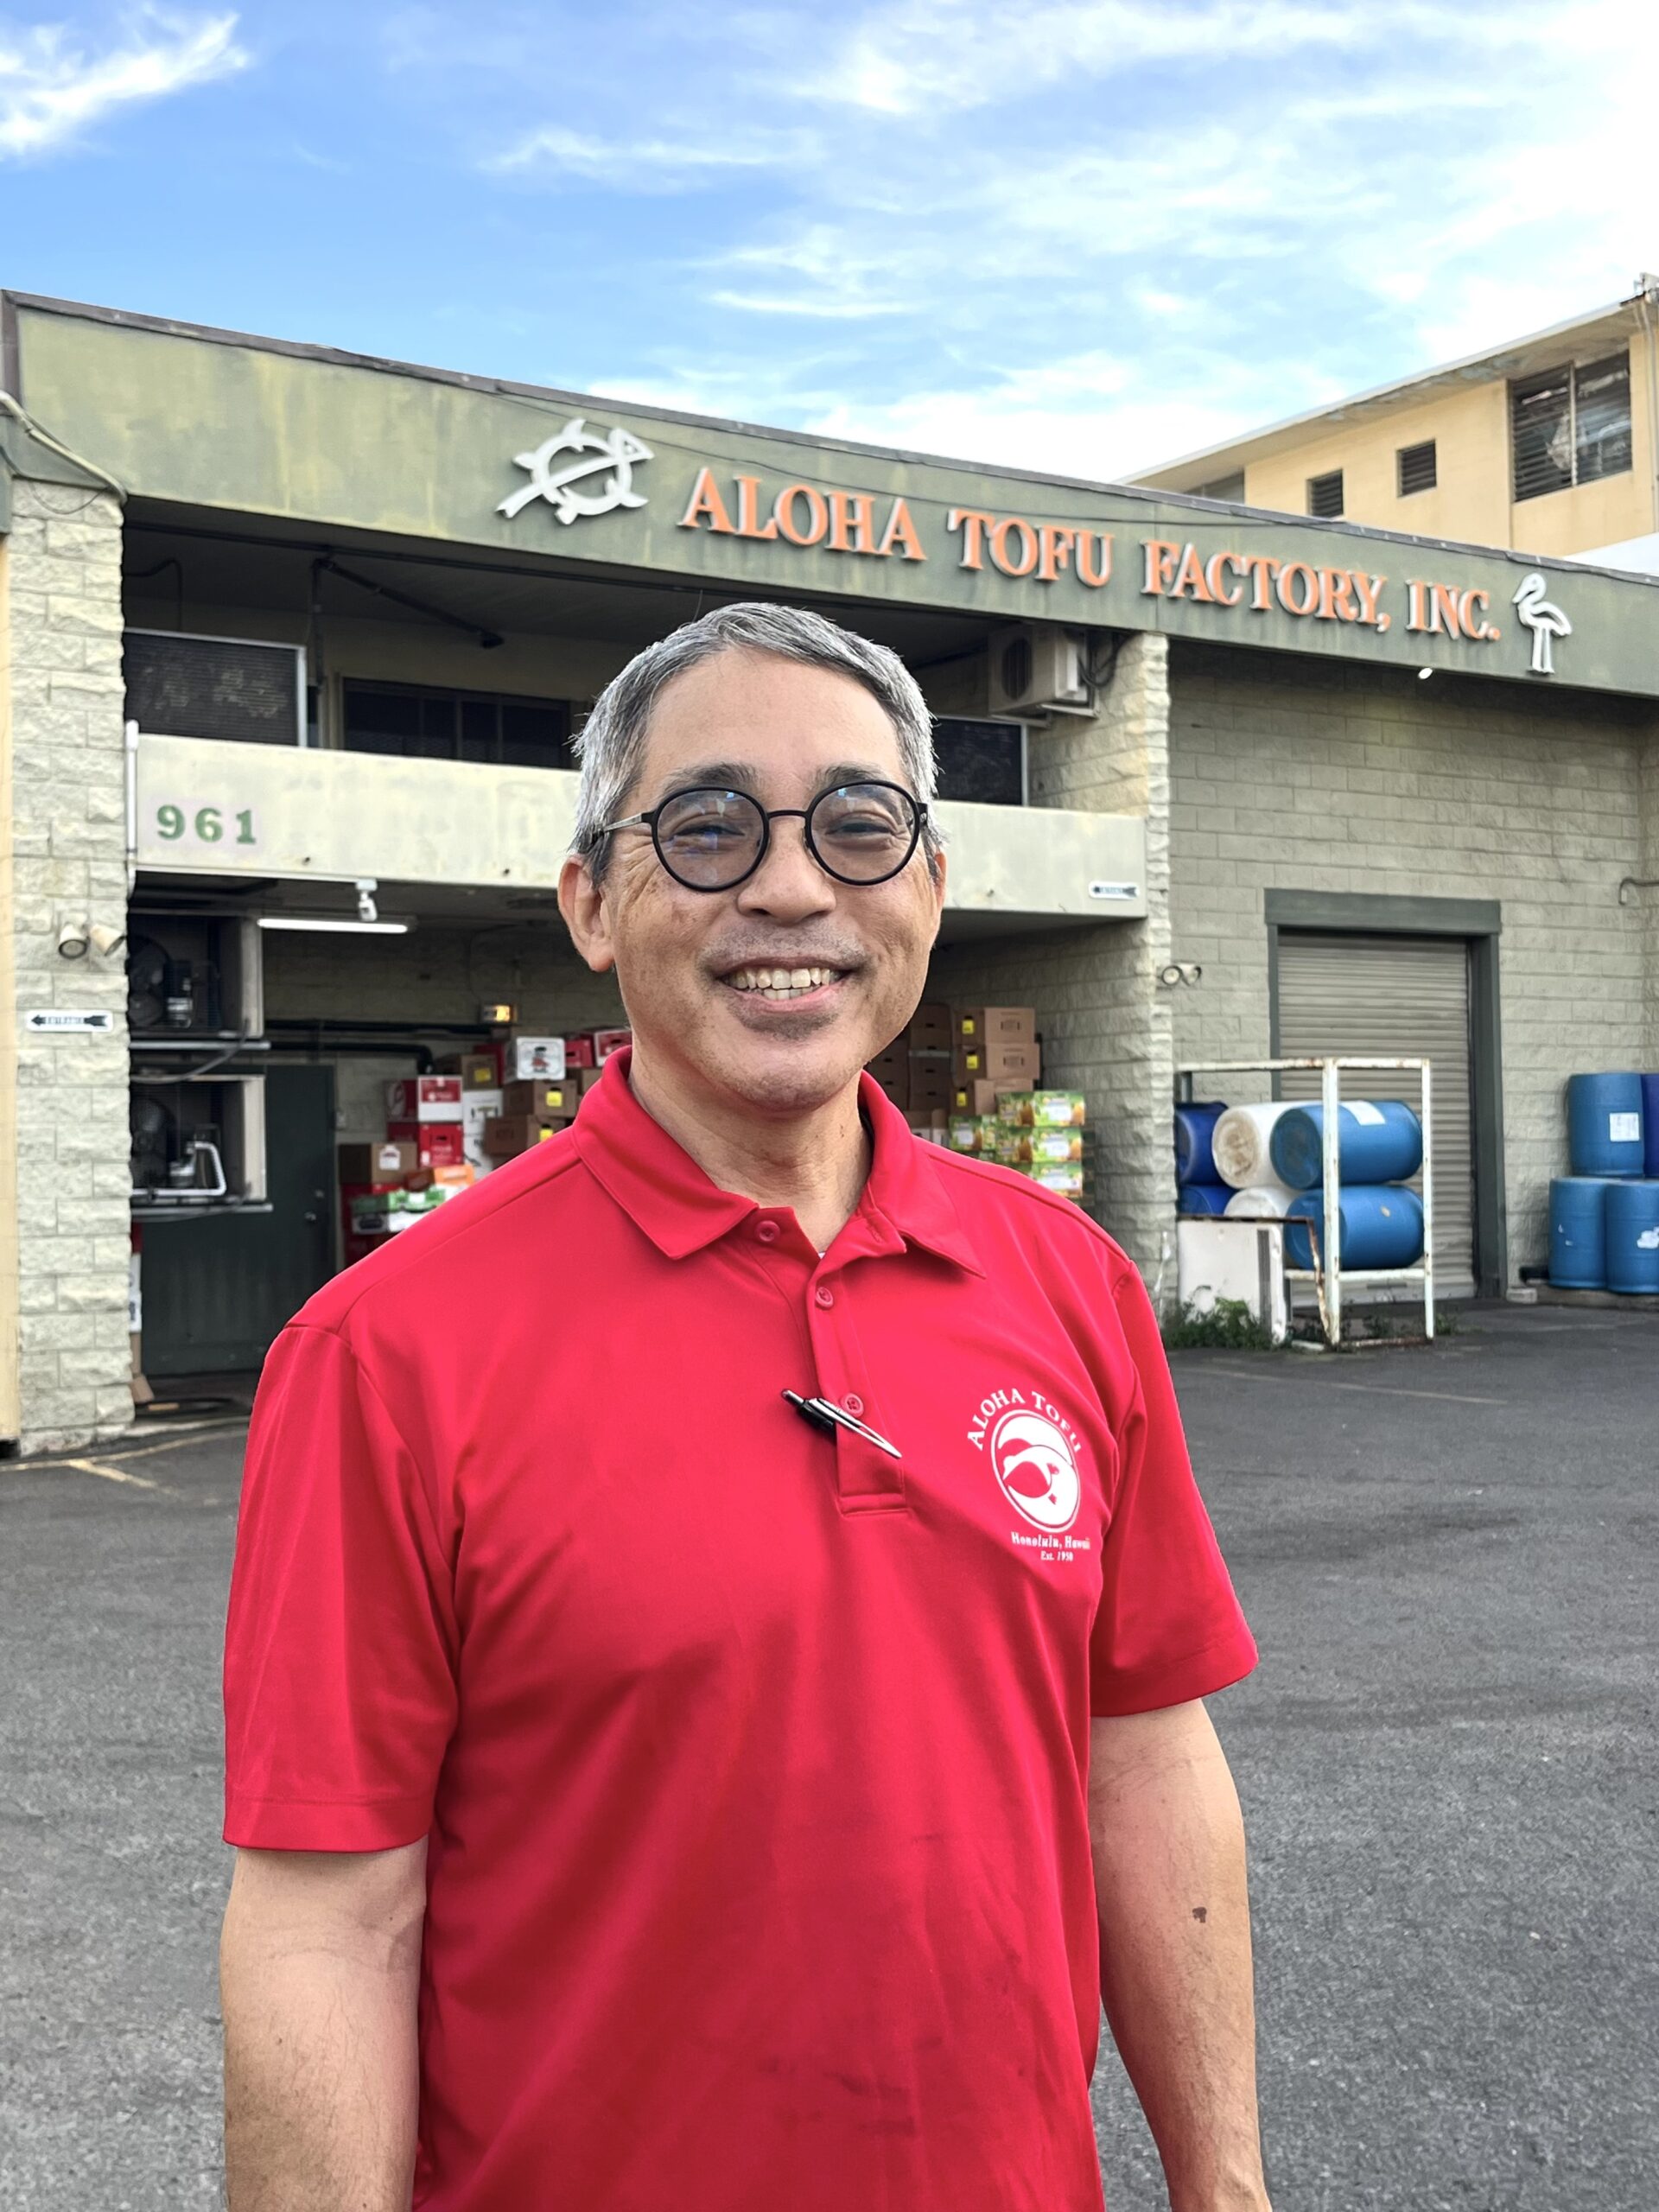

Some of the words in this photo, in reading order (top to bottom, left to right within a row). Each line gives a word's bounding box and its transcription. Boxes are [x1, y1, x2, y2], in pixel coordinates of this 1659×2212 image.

[677, 467, 928, 562] ALOHA
[947, 508, 1114, 587] TOFU
[1140, 538, 1391, 632] FACTORY,
[1405, 579, 1502, 640] INC.
[156, 804, 257, 844] 961
[967, 1388, 1026, 1451] ALOHA
[1011, 1531, 1062, 1549] Honolulu,
